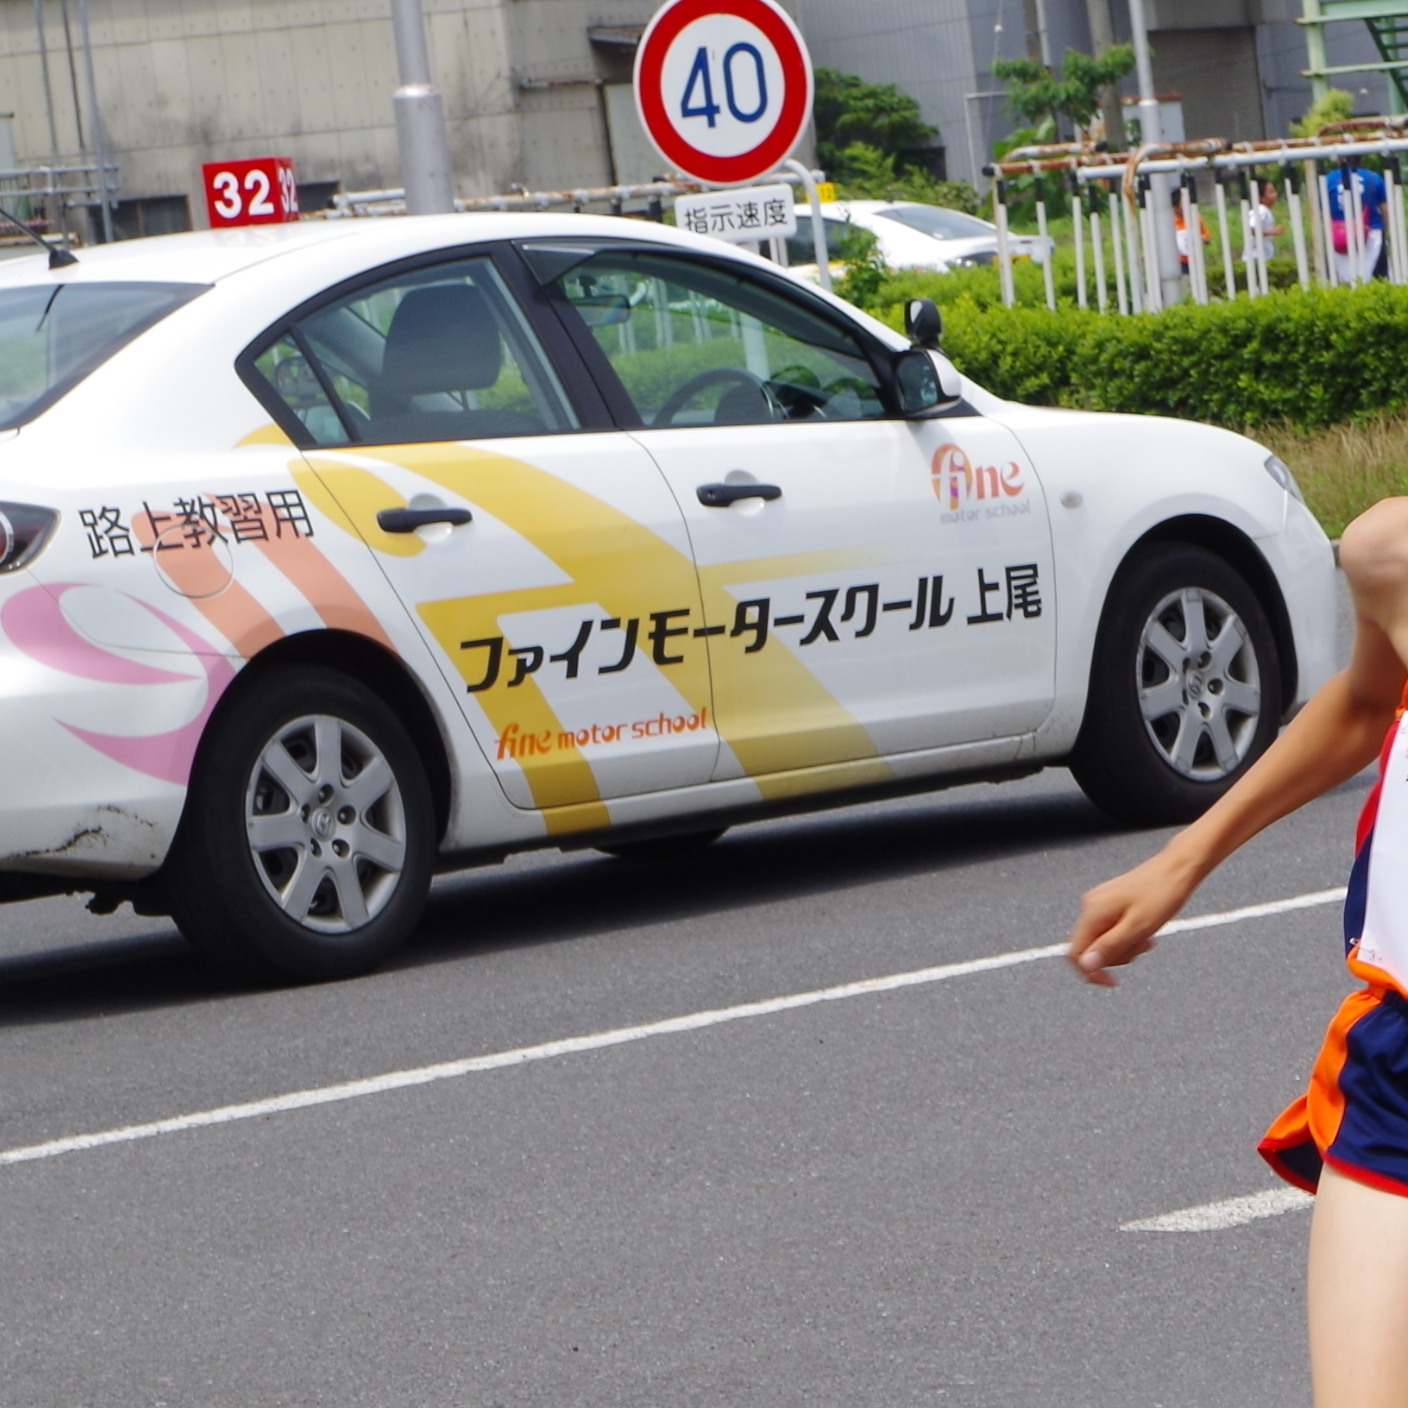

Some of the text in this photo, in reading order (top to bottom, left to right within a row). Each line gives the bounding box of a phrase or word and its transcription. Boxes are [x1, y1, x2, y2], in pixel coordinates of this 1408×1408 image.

[680, 41, 768, 129] 40
[213, 168, 275, 219] 32
[684, 198, 788, 234] 指示速度
[78, 489, 315, 560] 路上教習用
[460, 563, 1043, 693] ファインモータースクール 上尾
[494, 707, 708, 760] fine motor school
